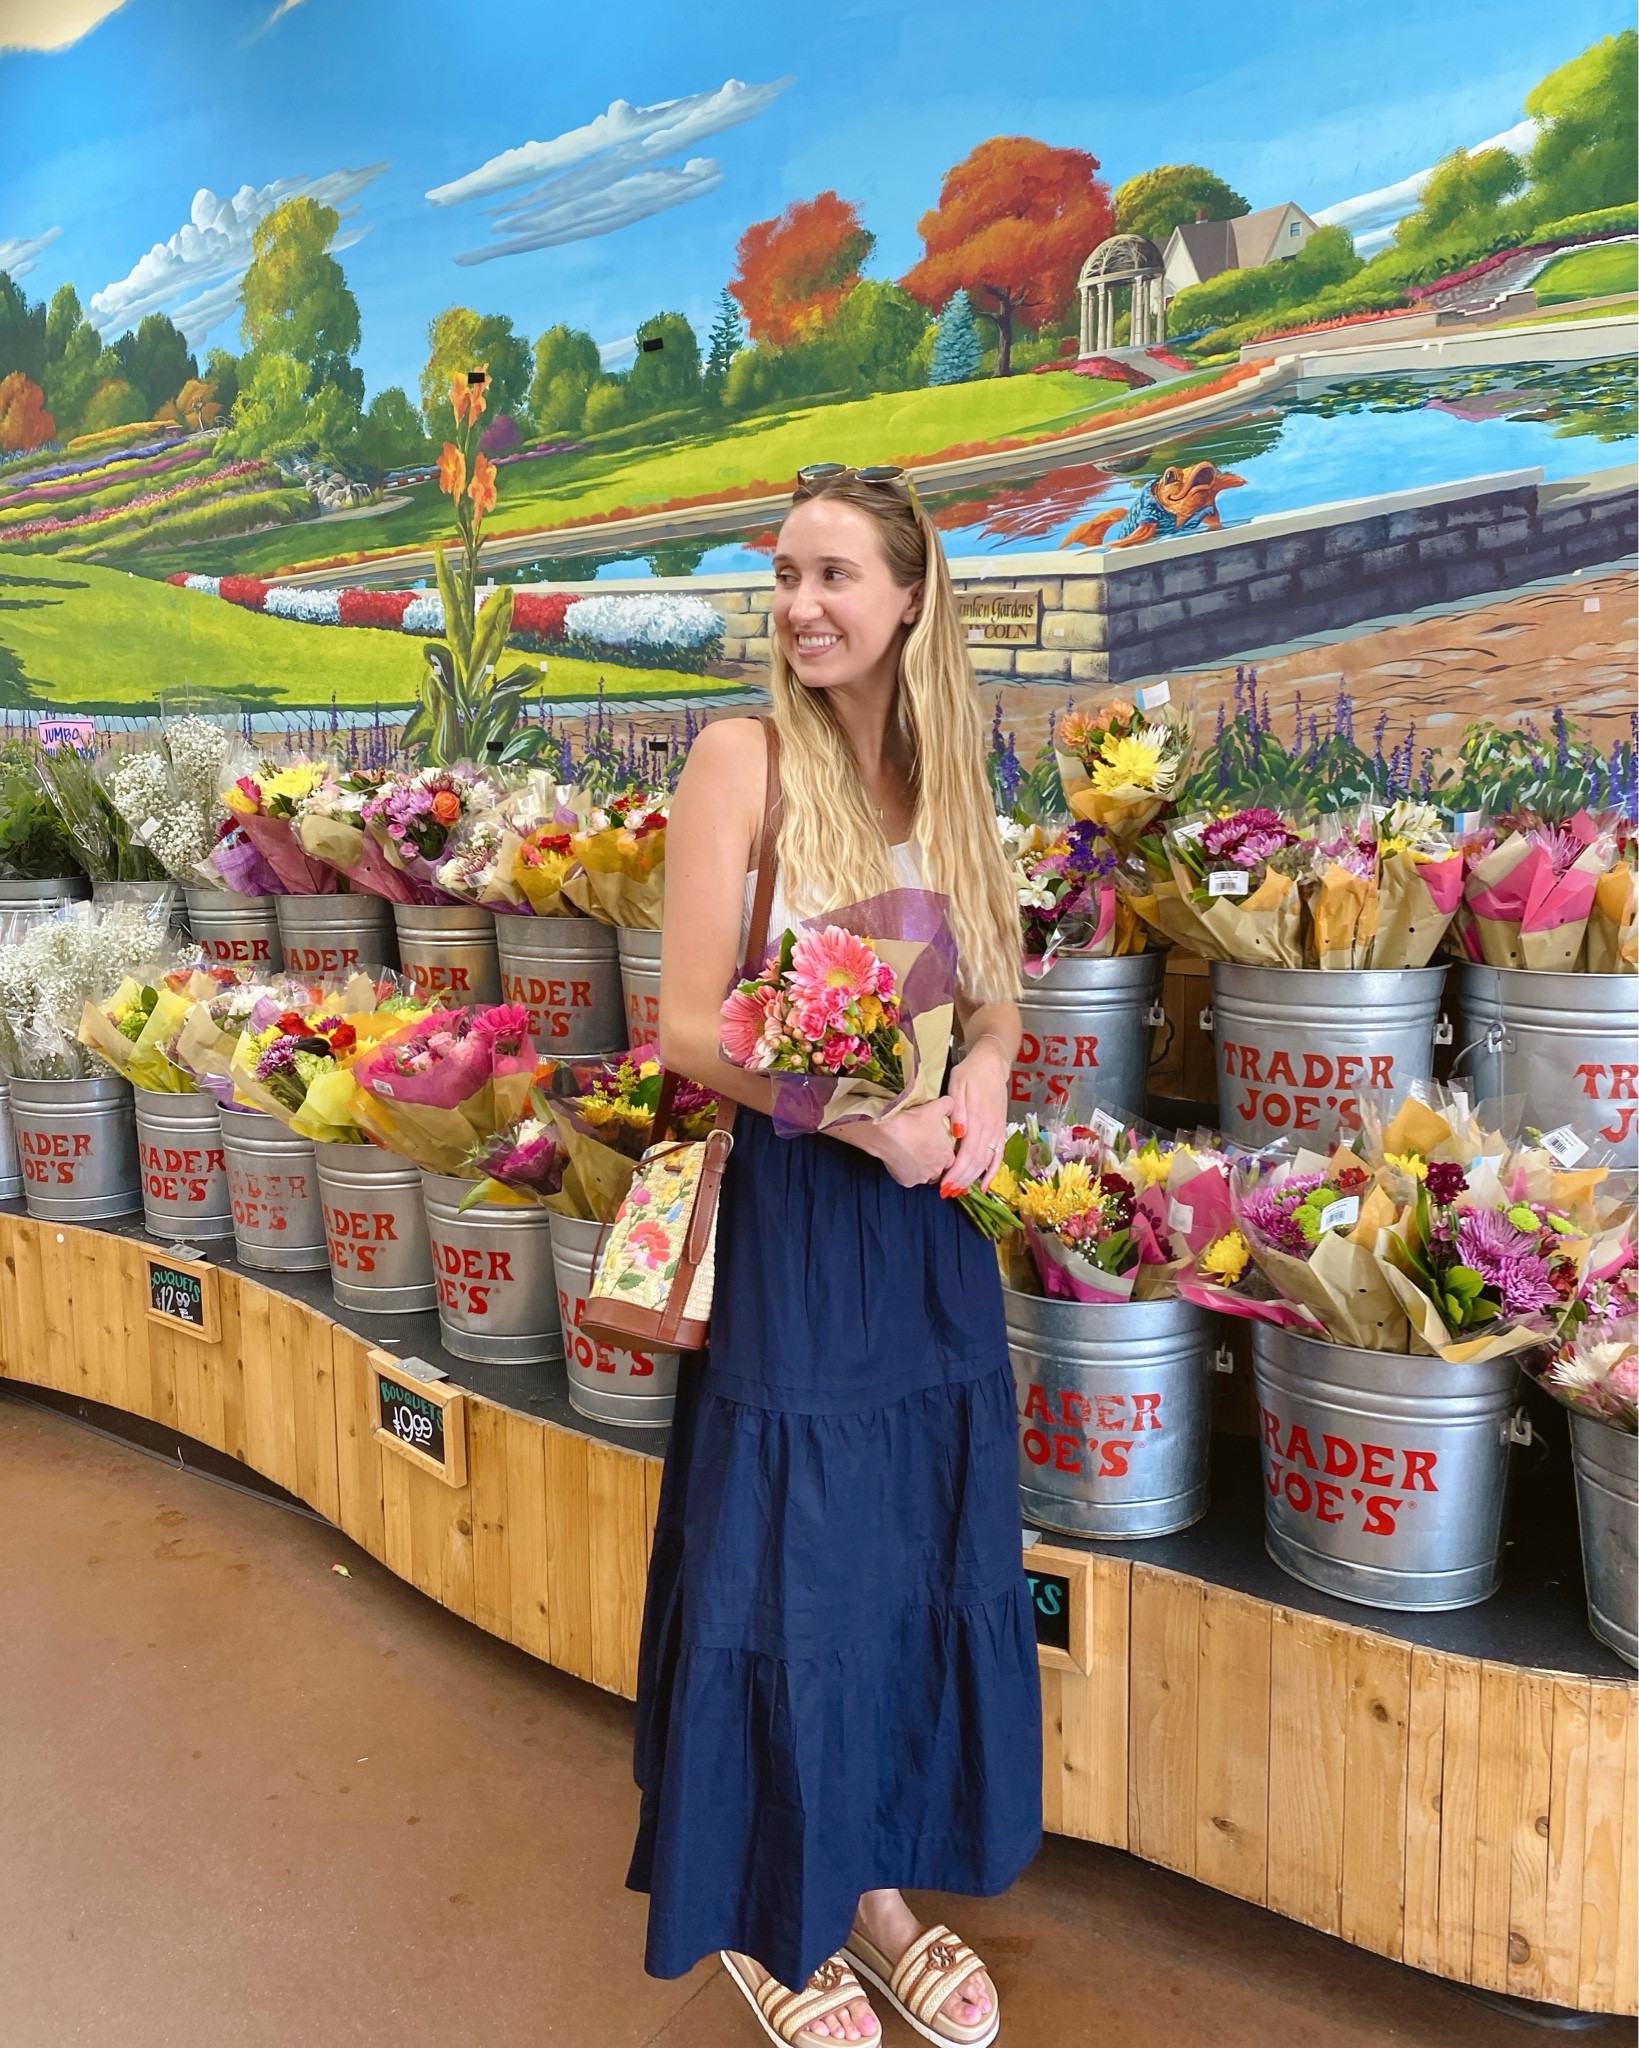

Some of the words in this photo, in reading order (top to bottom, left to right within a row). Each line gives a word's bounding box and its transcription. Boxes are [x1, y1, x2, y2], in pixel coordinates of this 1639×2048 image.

[991, 596, 1034, 623] Gardens
[961, 624, 1029, 639] COLN
[43, 726, 80, 745] JUMBO
[194, 939, 271, 961] ADER
[1016, 1033, 1100, 1067] DER
[1222, 1041, 1394, 1090] TRADER
[1236, 1088, 1363, 1132] JOE'S
[142, 1172, 209, 1201] JOE'S
[229, 1171, 308, 1200] ADER
[563, 1329, 654, 1377] JOE'S
[381, 1382, 443, 1431] BOUQUETS
[1014, 1379, 1163, 1431] ADER
[1258, 1402, 1439, 1492] RADER
[1266, 1459, 1403, 1536] JOE'S
